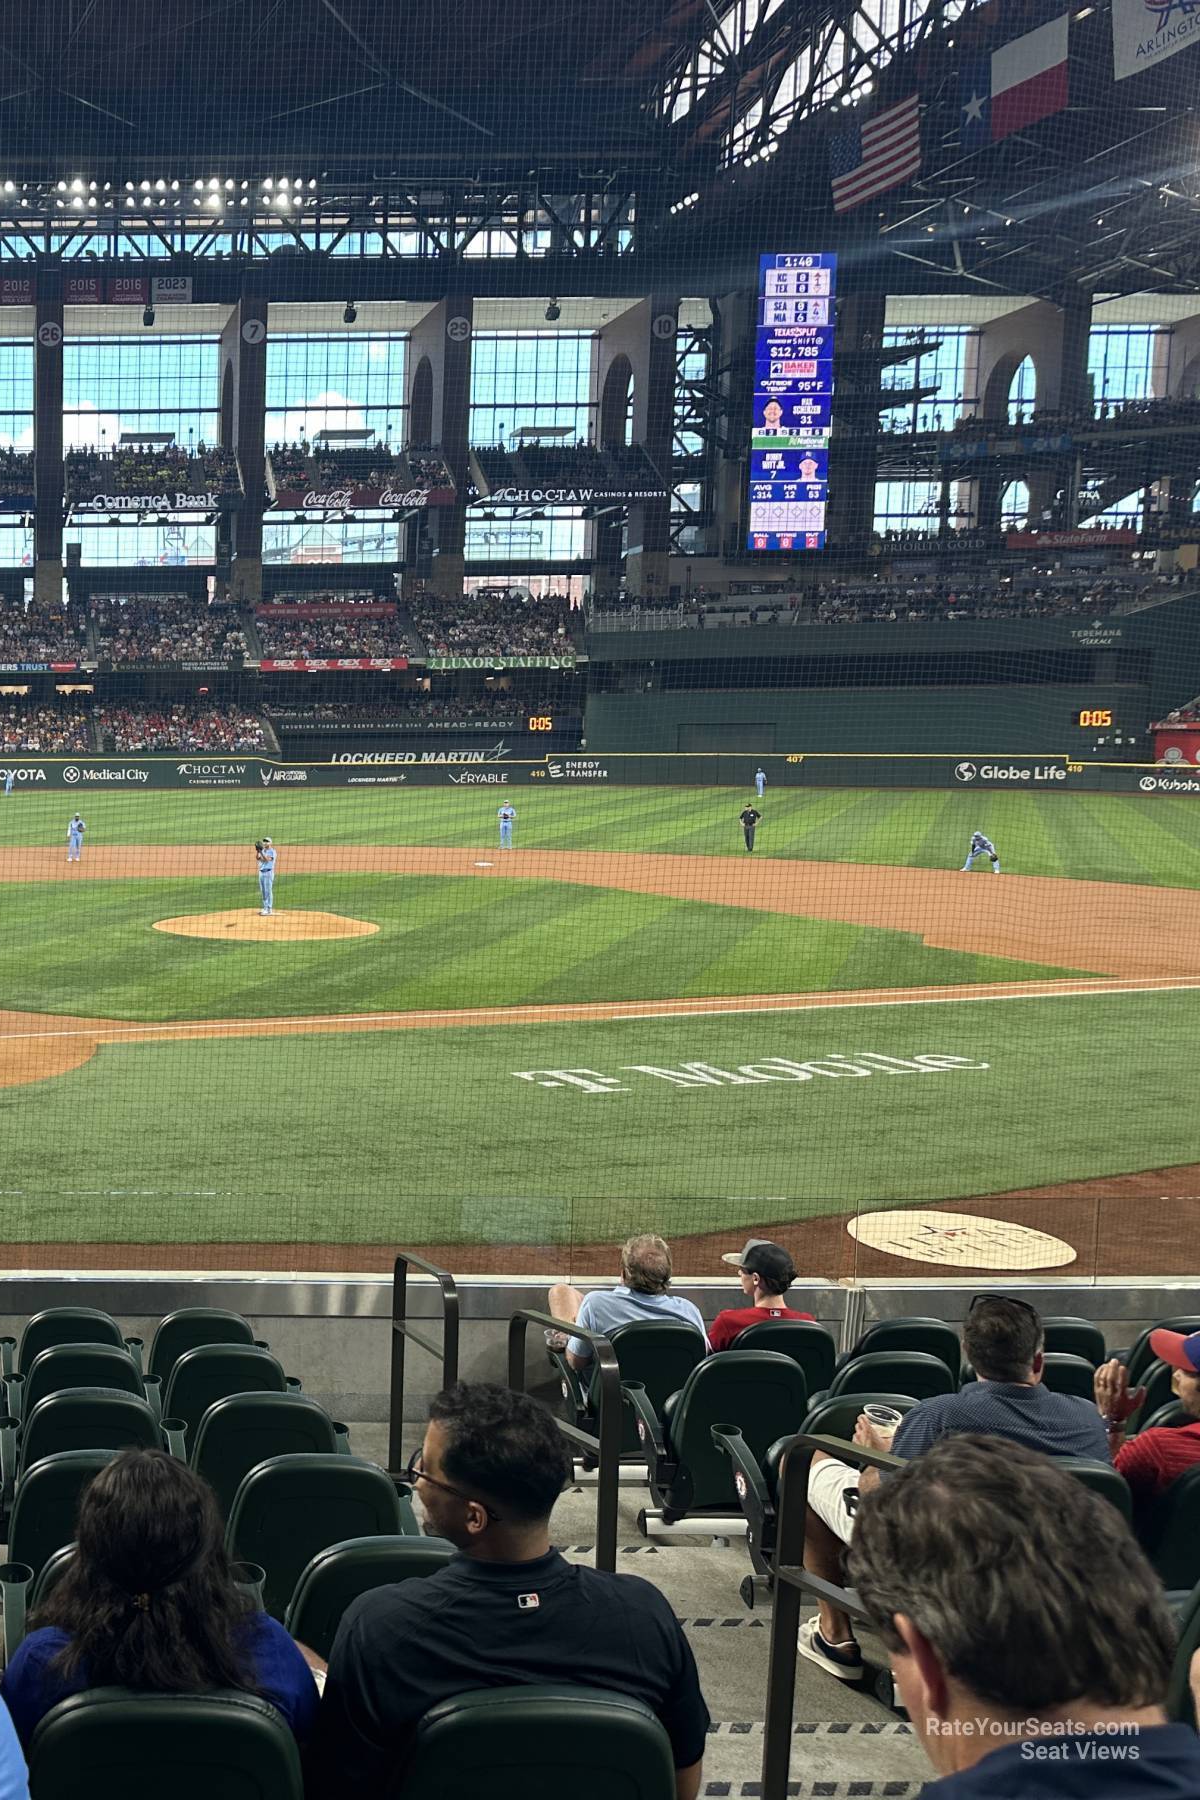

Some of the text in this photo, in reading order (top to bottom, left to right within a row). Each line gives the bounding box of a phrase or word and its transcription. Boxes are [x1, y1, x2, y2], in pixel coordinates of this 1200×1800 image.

[784, 256, 813, 267] 1:40
[158, 278, 187, 290] 2023
[777, 274, 788, 282] KC
[3, 280, 30, 292] 2012
[70, 279, 96, 292] 2015
[115, 279, 142, 292] 2016
[775, 284, 788, 294] TEX
[774, 302, 788, 311] SEA
[774, 313, 786, 322] MIA
[248, 324, 260, 336] 7
[450, 322, 468, 336] 29
[657, 320, 672, 334] 10
[774, 328, 818, 336] TEXAS SPLIT
[40, 326, 60, 342] 26
[770, 346, 818, 358] $12,785
[798, 381, 823, 391] 95°F
[800, 416, 812, 424] 31
[797, 437, 825, 445] National
[175, 492, 219, 508] Bank
[302, 490, 354, 508] Coca-Cola
[378, 489, 432, 506] Coca-Cola
[504, 488, 593, 502] CHOCTAW
[784, 490, 820, 499] 12 53
[883, 539, 984, 552] PRIORITY GOLD
[1071, 630, 1122, 638] TEREMANA
[370, 658, 394, 666] DEX
[442, 656, 572, 668] LUXOR STAFFING
[529, 716, 552, 730] 0:05
[1080, 710, 1112, 726] 0:05
[331, 752, 485, 764] LOCKHEED MARTIN
[184, 764, 246, 774] CHOCTAW
[272, 770, 286, 780] AIR
[530, 770, 546, 778] 410
[565, 770, 608, 778] TRANSFER
[980, 764, 1067, 780] Globe Life
[82, 769, 150, 784] Medical City
[448, 771, 508, 784] VERYABLE
[1158, 778, 1200, 791] Kubota
